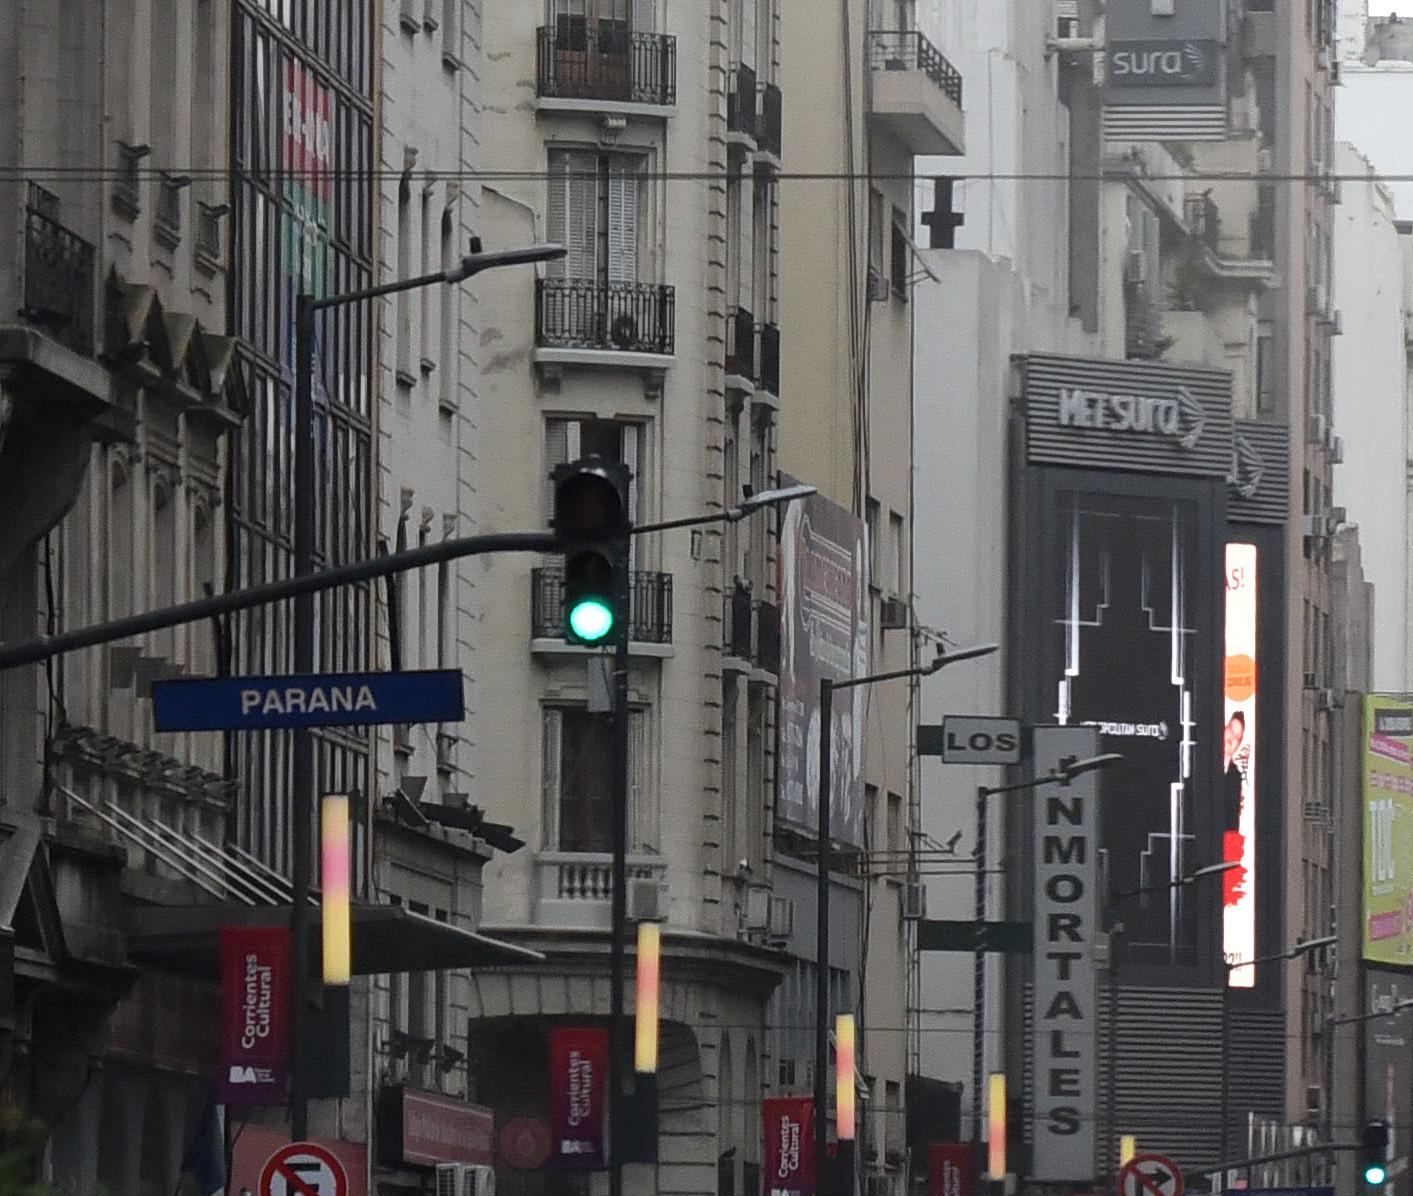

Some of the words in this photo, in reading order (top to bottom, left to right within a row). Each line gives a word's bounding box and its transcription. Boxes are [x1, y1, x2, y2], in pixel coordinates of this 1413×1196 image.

[1112, 49, 1183, 77] sura
[1109, 395, 1180, 435] sura
[241, 687, 377, 716] PARANA
[946, 731, 1017, 754] LOS
[241, 952, 258, 1050] Corrientes
[257, 965, 272, 1039] Cultural
[229, 1065, 257, 1084] BA
[568, 1050, 582, 1126] Corrientes
[579, 1058, 593, 1117] Cultural
[778, 1114, 791, 1178] Corrientes
[789, 1122, 801, 1171] Cultural
